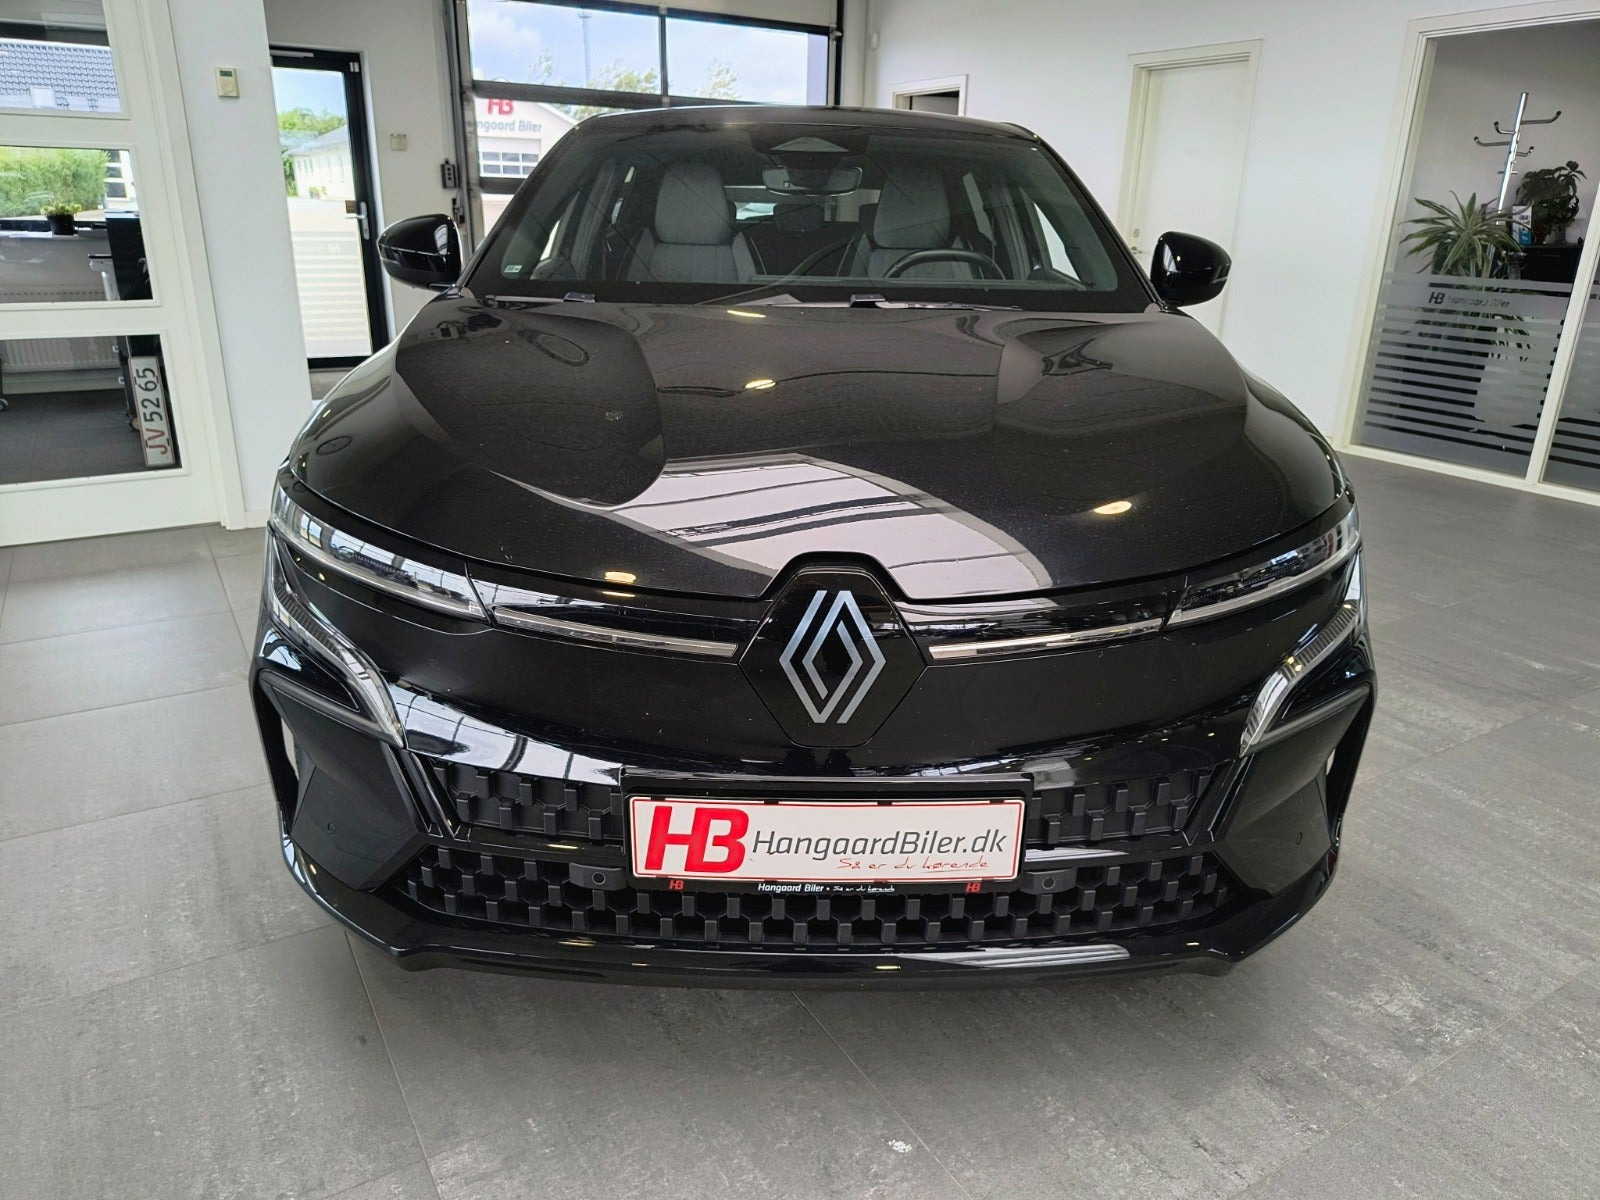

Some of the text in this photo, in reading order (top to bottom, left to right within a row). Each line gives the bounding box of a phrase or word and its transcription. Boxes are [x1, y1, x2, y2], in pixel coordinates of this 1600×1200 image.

[487, 98, 514, 115] HB
[476, 120, 542, 132] ngaard Biler
[1428, 291, 1446, 304] HB
[644, 804, 1007, 874] HB HangaardBiler.dk
[669, 879, 685, 890] HB
[758, 883, 802, 893] Hangaard
[804, 884, 824, 892] Biler
[966, 882, 981, 893] HB
